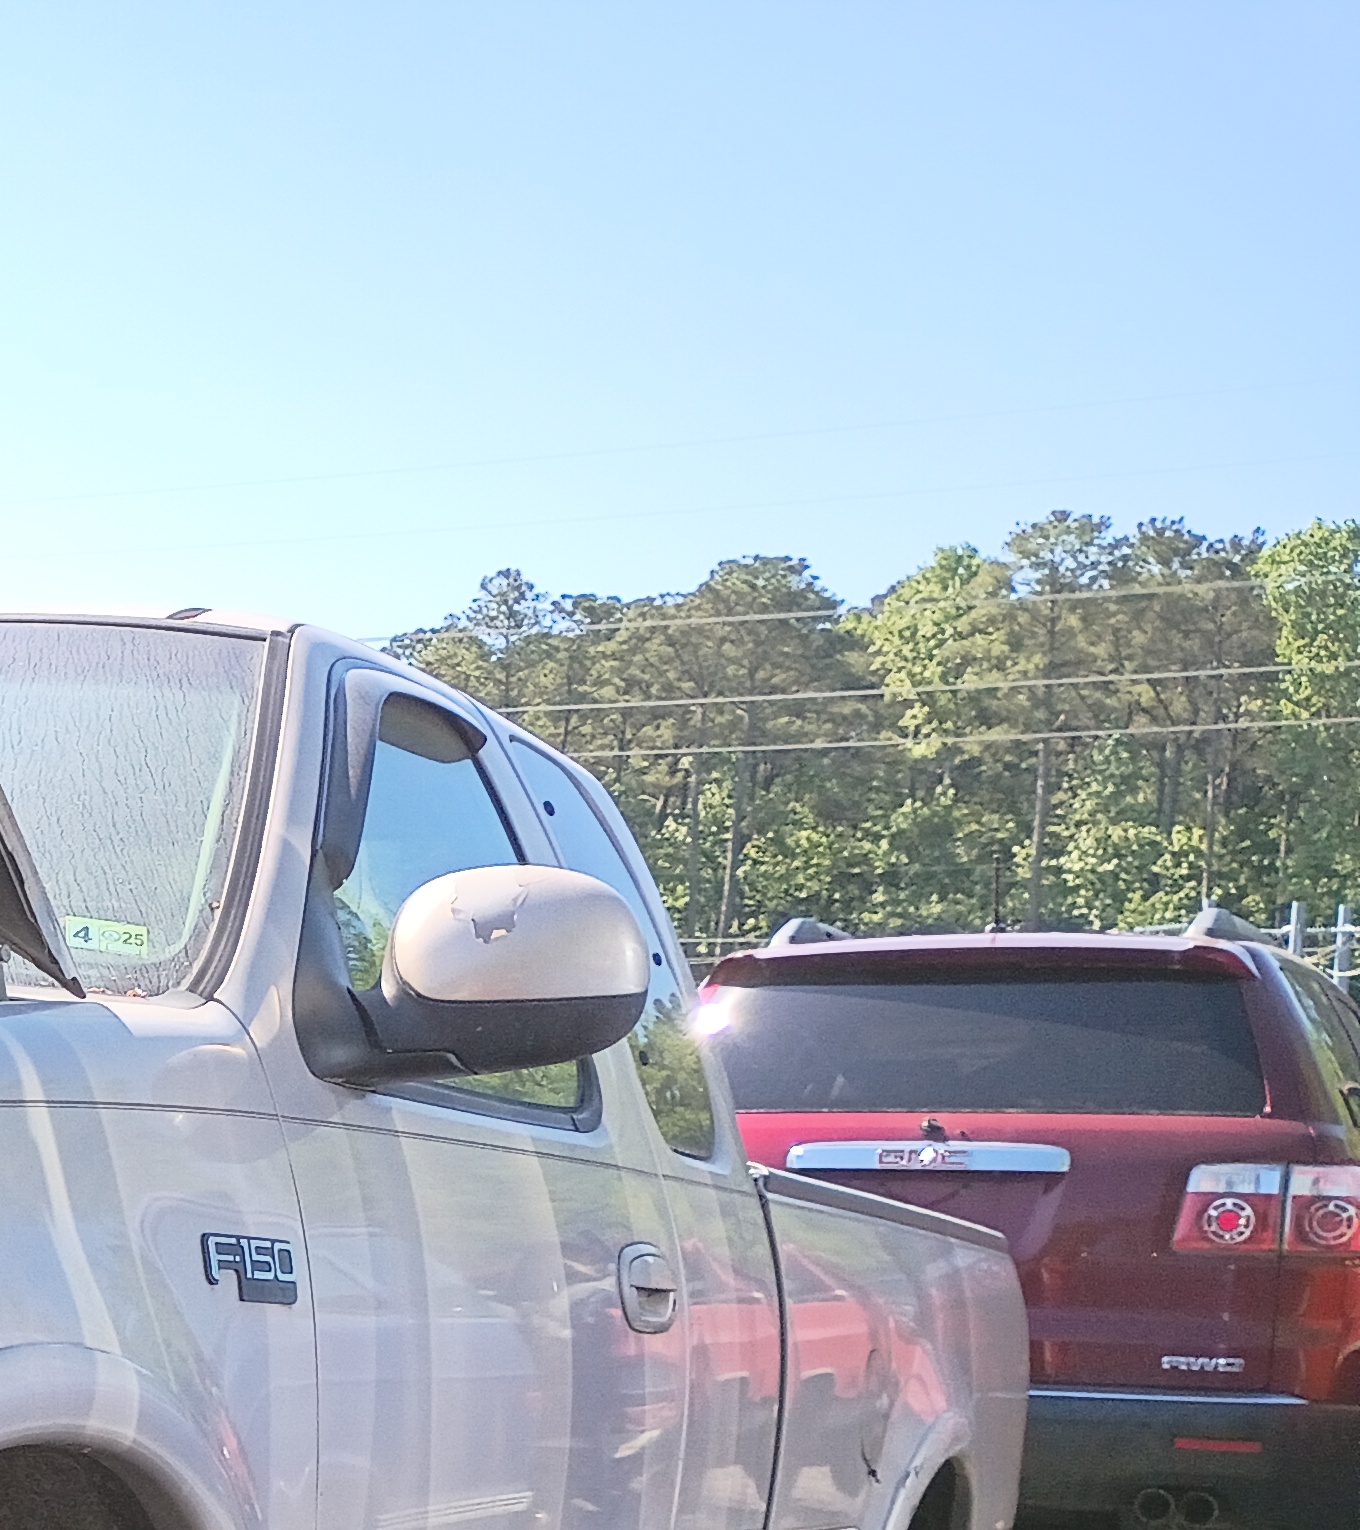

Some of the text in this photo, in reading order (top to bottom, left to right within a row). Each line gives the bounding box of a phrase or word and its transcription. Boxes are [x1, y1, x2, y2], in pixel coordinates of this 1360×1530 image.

[73, 926, 144, 946] 4 25
[208, 1236, 296, 1281] F-150
